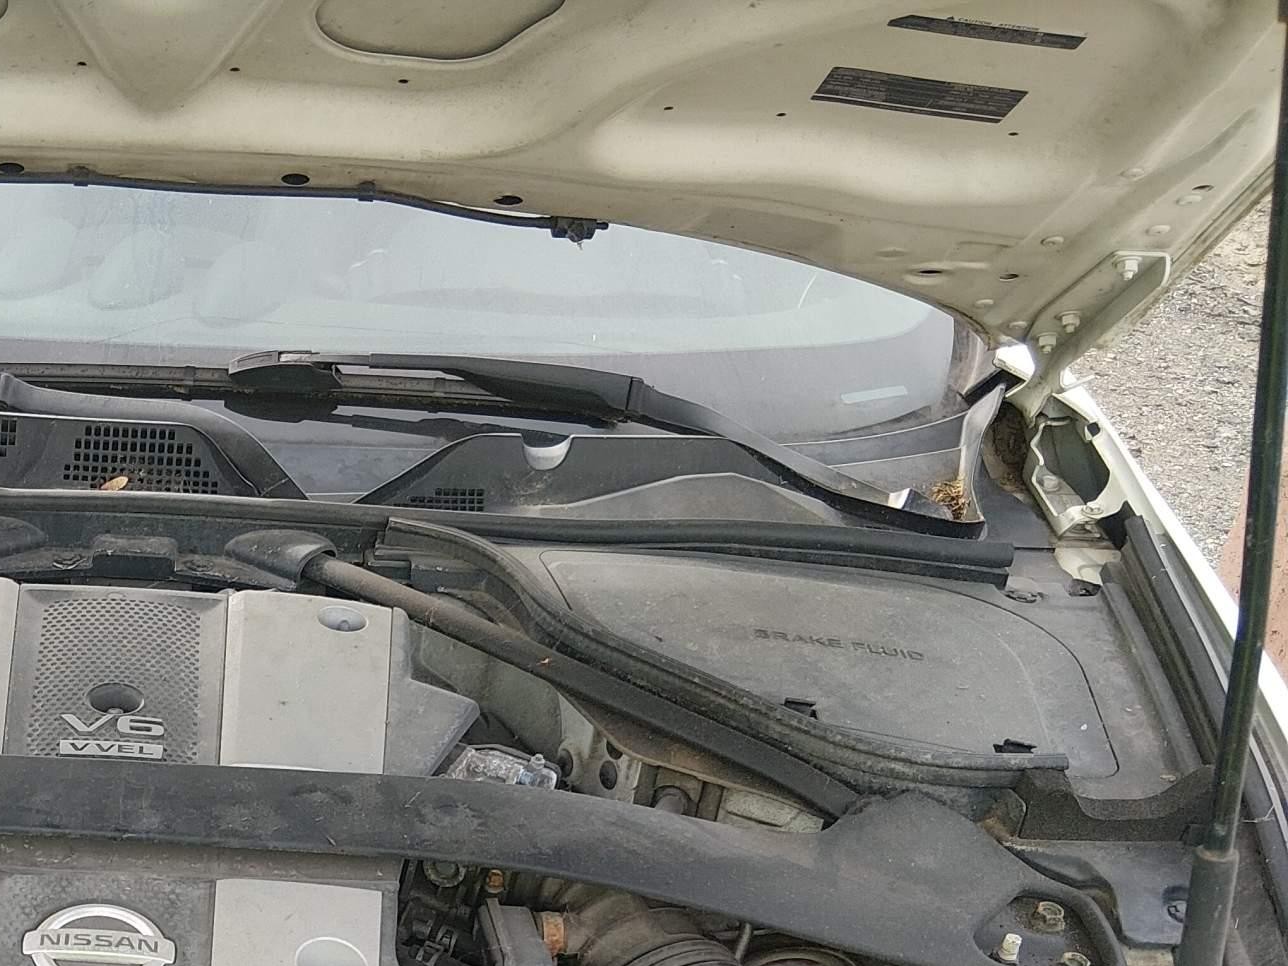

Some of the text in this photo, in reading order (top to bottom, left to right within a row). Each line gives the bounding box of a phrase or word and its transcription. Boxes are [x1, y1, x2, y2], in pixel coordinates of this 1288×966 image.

[754, 628, 925, 661] BRAKE FLUID
[60, 713, 165, 737] V6
[69, 742, 154, 755] VVEL
[39, 933, 159, 953] NISSAN
